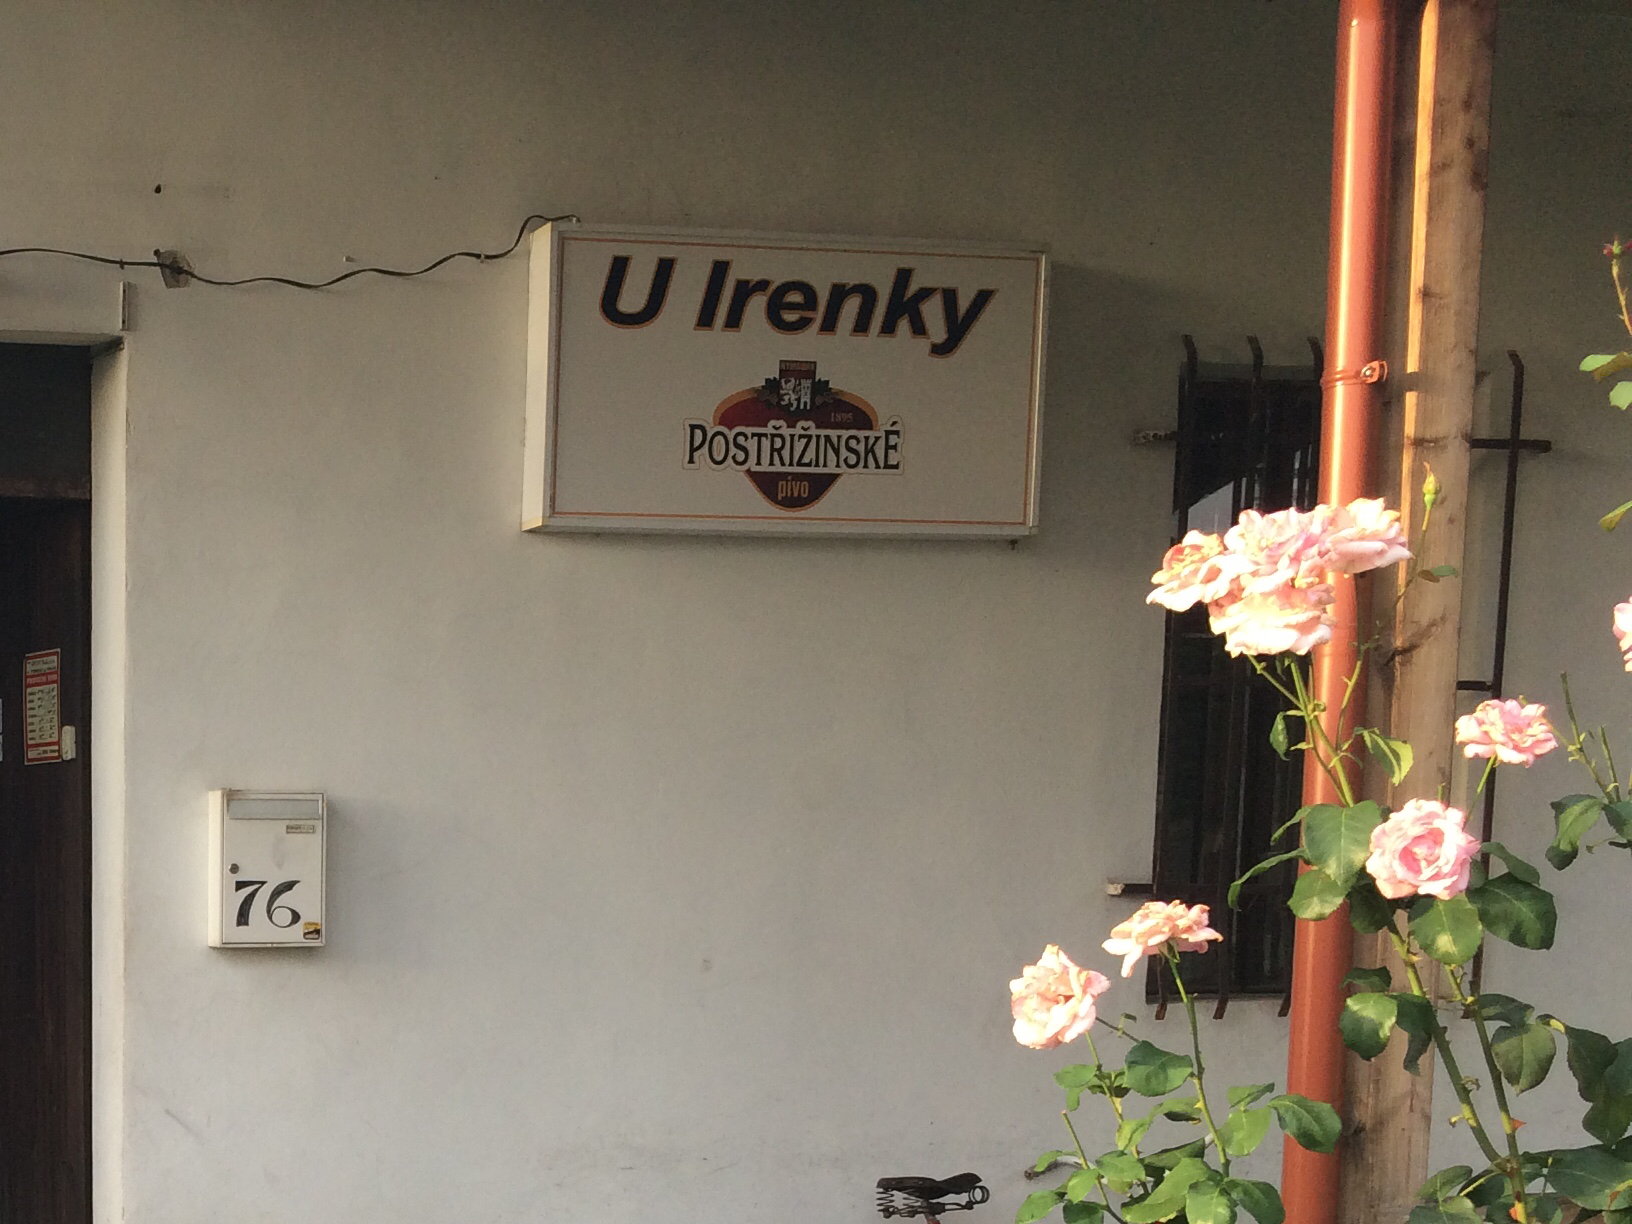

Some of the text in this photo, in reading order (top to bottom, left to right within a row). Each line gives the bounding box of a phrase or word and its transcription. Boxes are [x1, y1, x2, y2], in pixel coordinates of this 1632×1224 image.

[599, 254, 999, 359] U Irenky
[234, 879, 302, 929] 76
